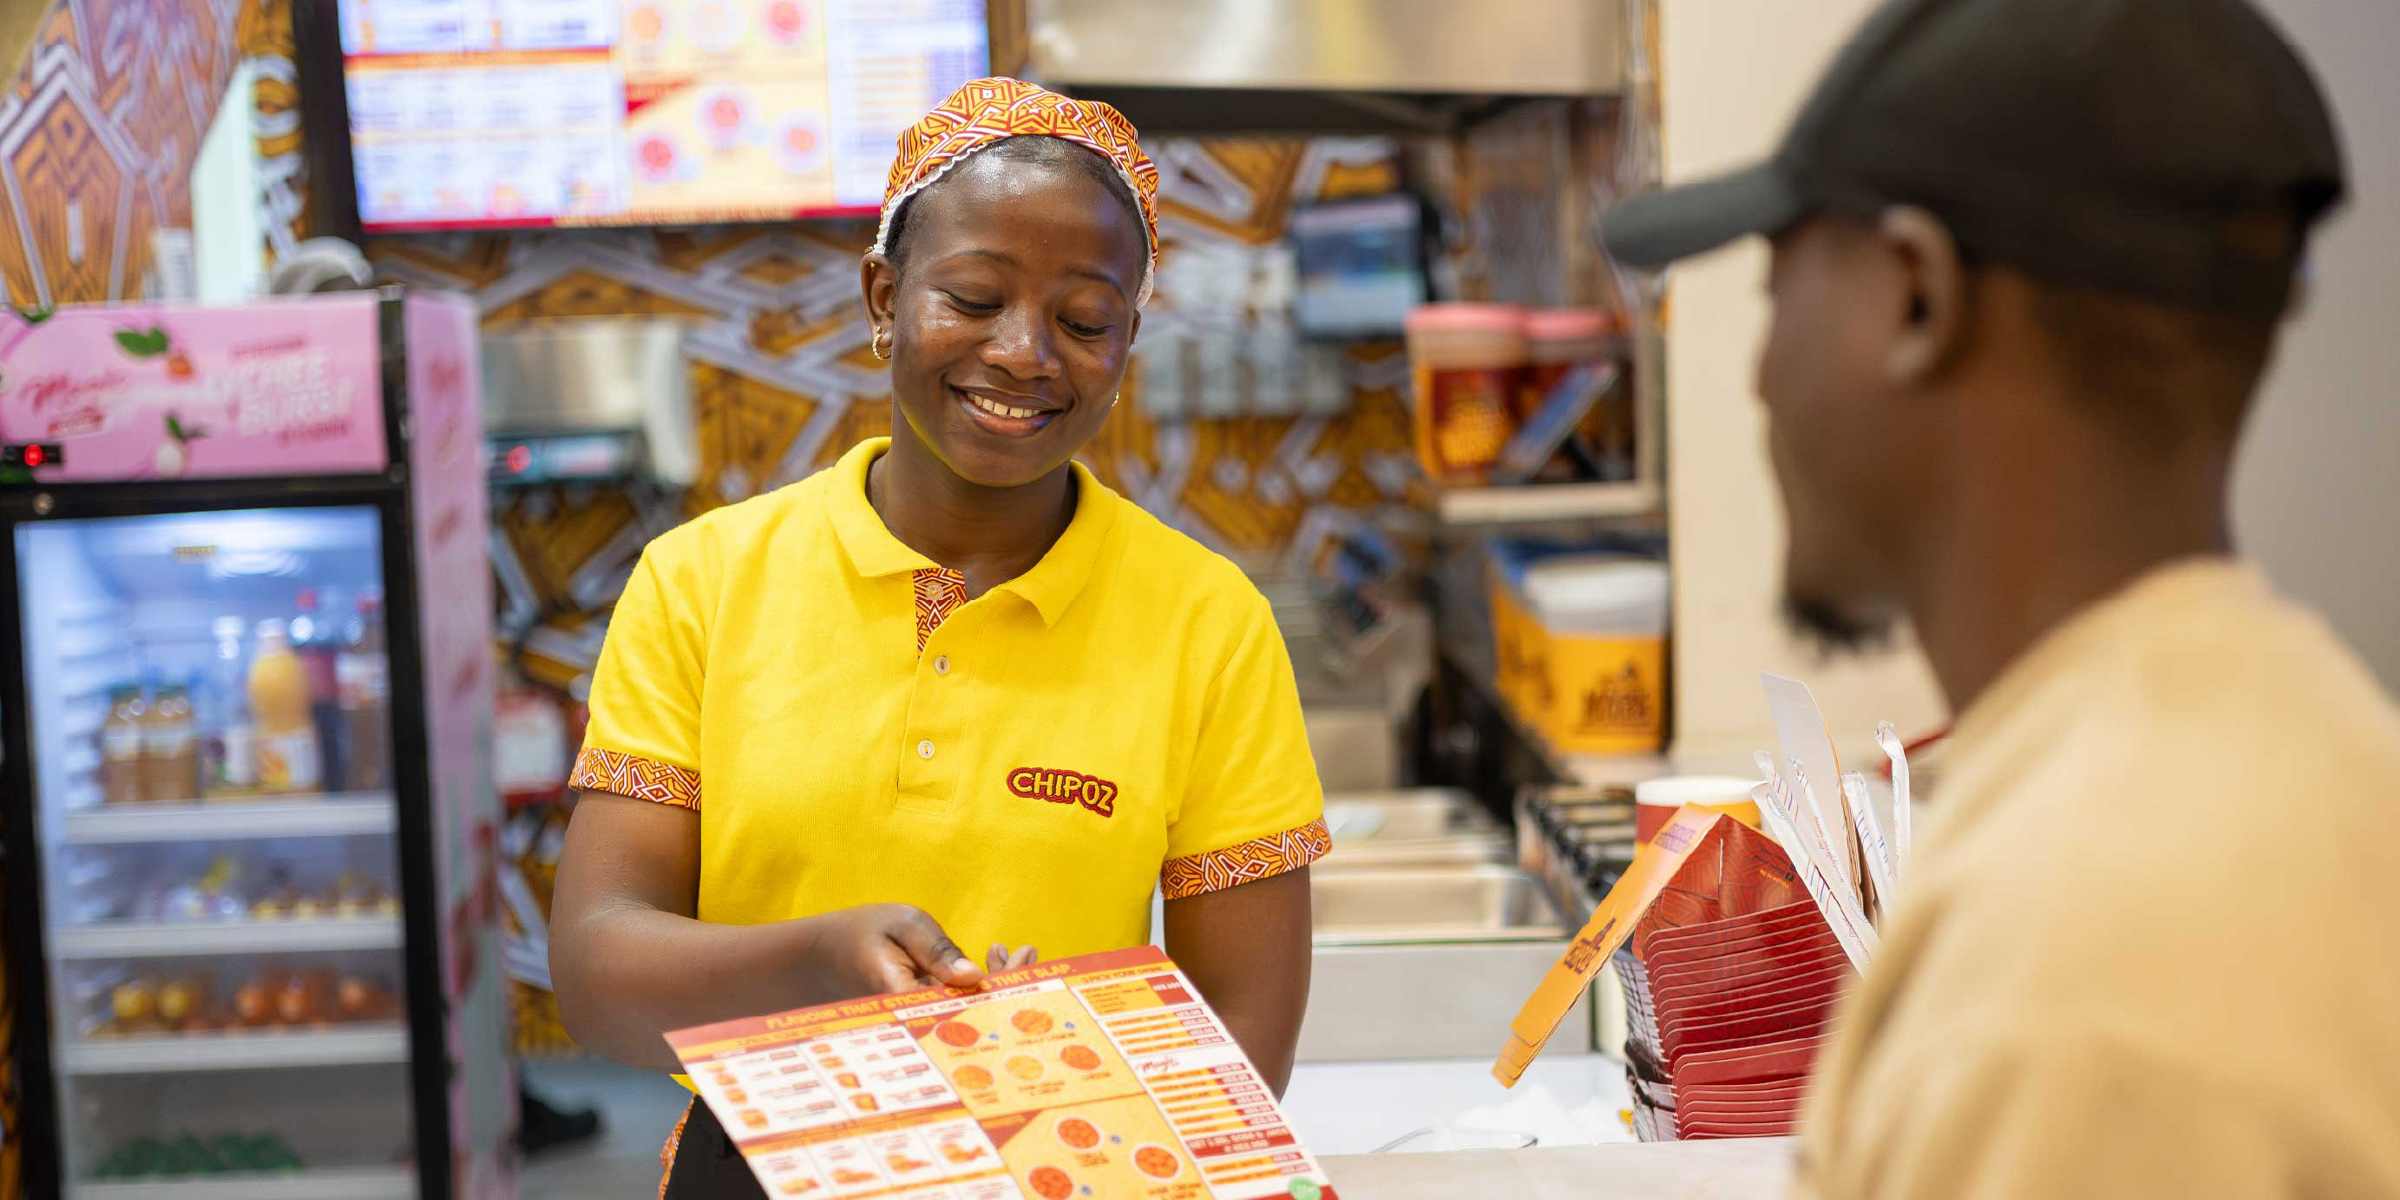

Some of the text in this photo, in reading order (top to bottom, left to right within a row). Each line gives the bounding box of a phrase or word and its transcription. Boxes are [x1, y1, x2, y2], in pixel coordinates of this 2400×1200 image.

[1011, 771, 1114, 813] CHIPOZ
[765, 1007, 839, 1030] FLAVOUR
[839, 1000, 880, 1017] THAT
[883, 990, 944, 1009] STICKS.
[990, 969, 1032, 988] THAT
[1033, 963, 1077, 979] SLAP.
